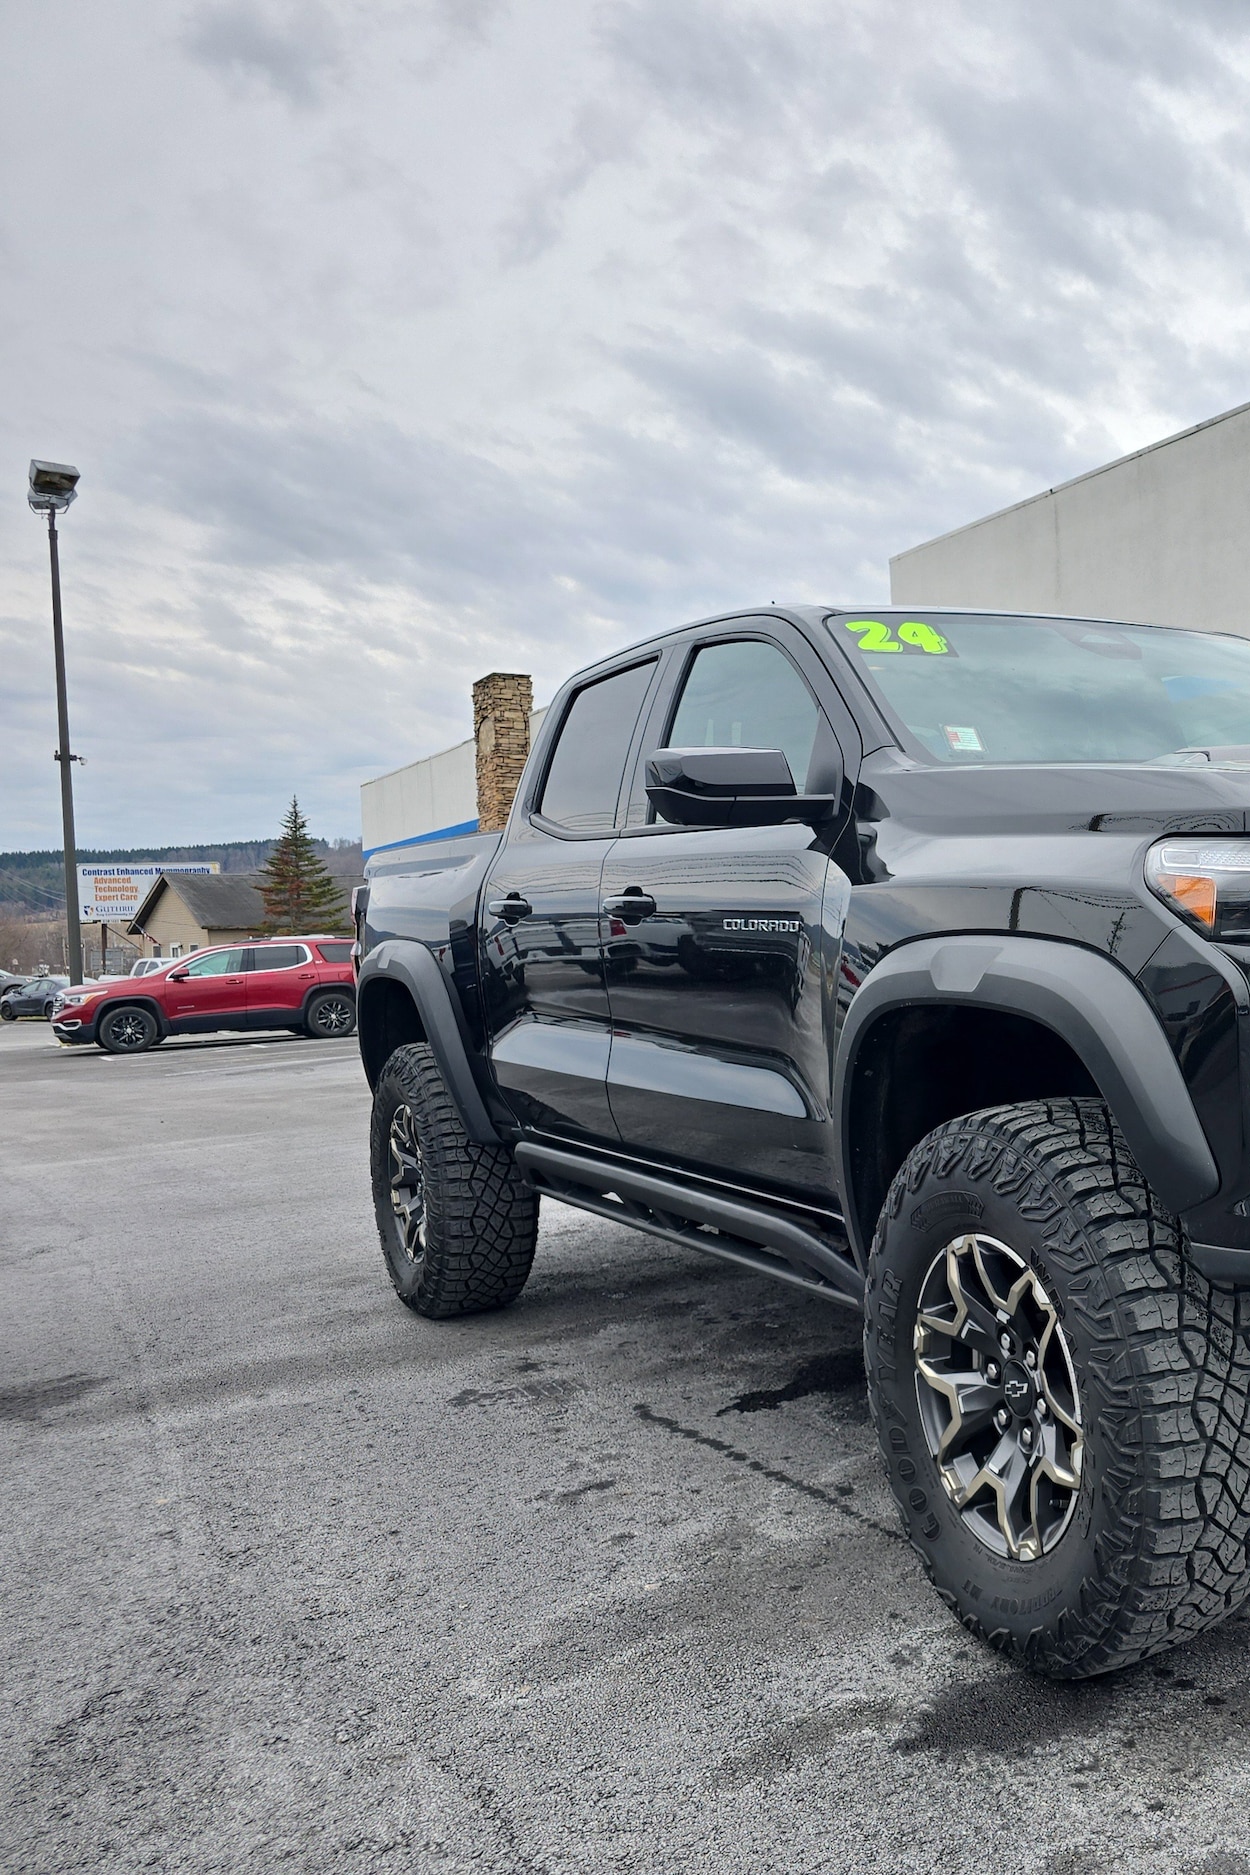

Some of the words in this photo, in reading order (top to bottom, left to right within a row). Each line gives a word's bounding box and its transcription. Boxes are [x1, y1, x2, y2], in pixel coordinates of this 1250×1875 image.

[845, 620, 949, 654] 24
[82, 868, 115, 876] Contrast
[117, 867, 153, 876] Enhanced
[94, 876, 131, 884] Advanced
[95, 893, 118, 902] Expert
[120, 893, 138, 901] Care
[723, 918, 800, 932] COLORADO
[875, 1267, 942, 1541] GOODYEAR
